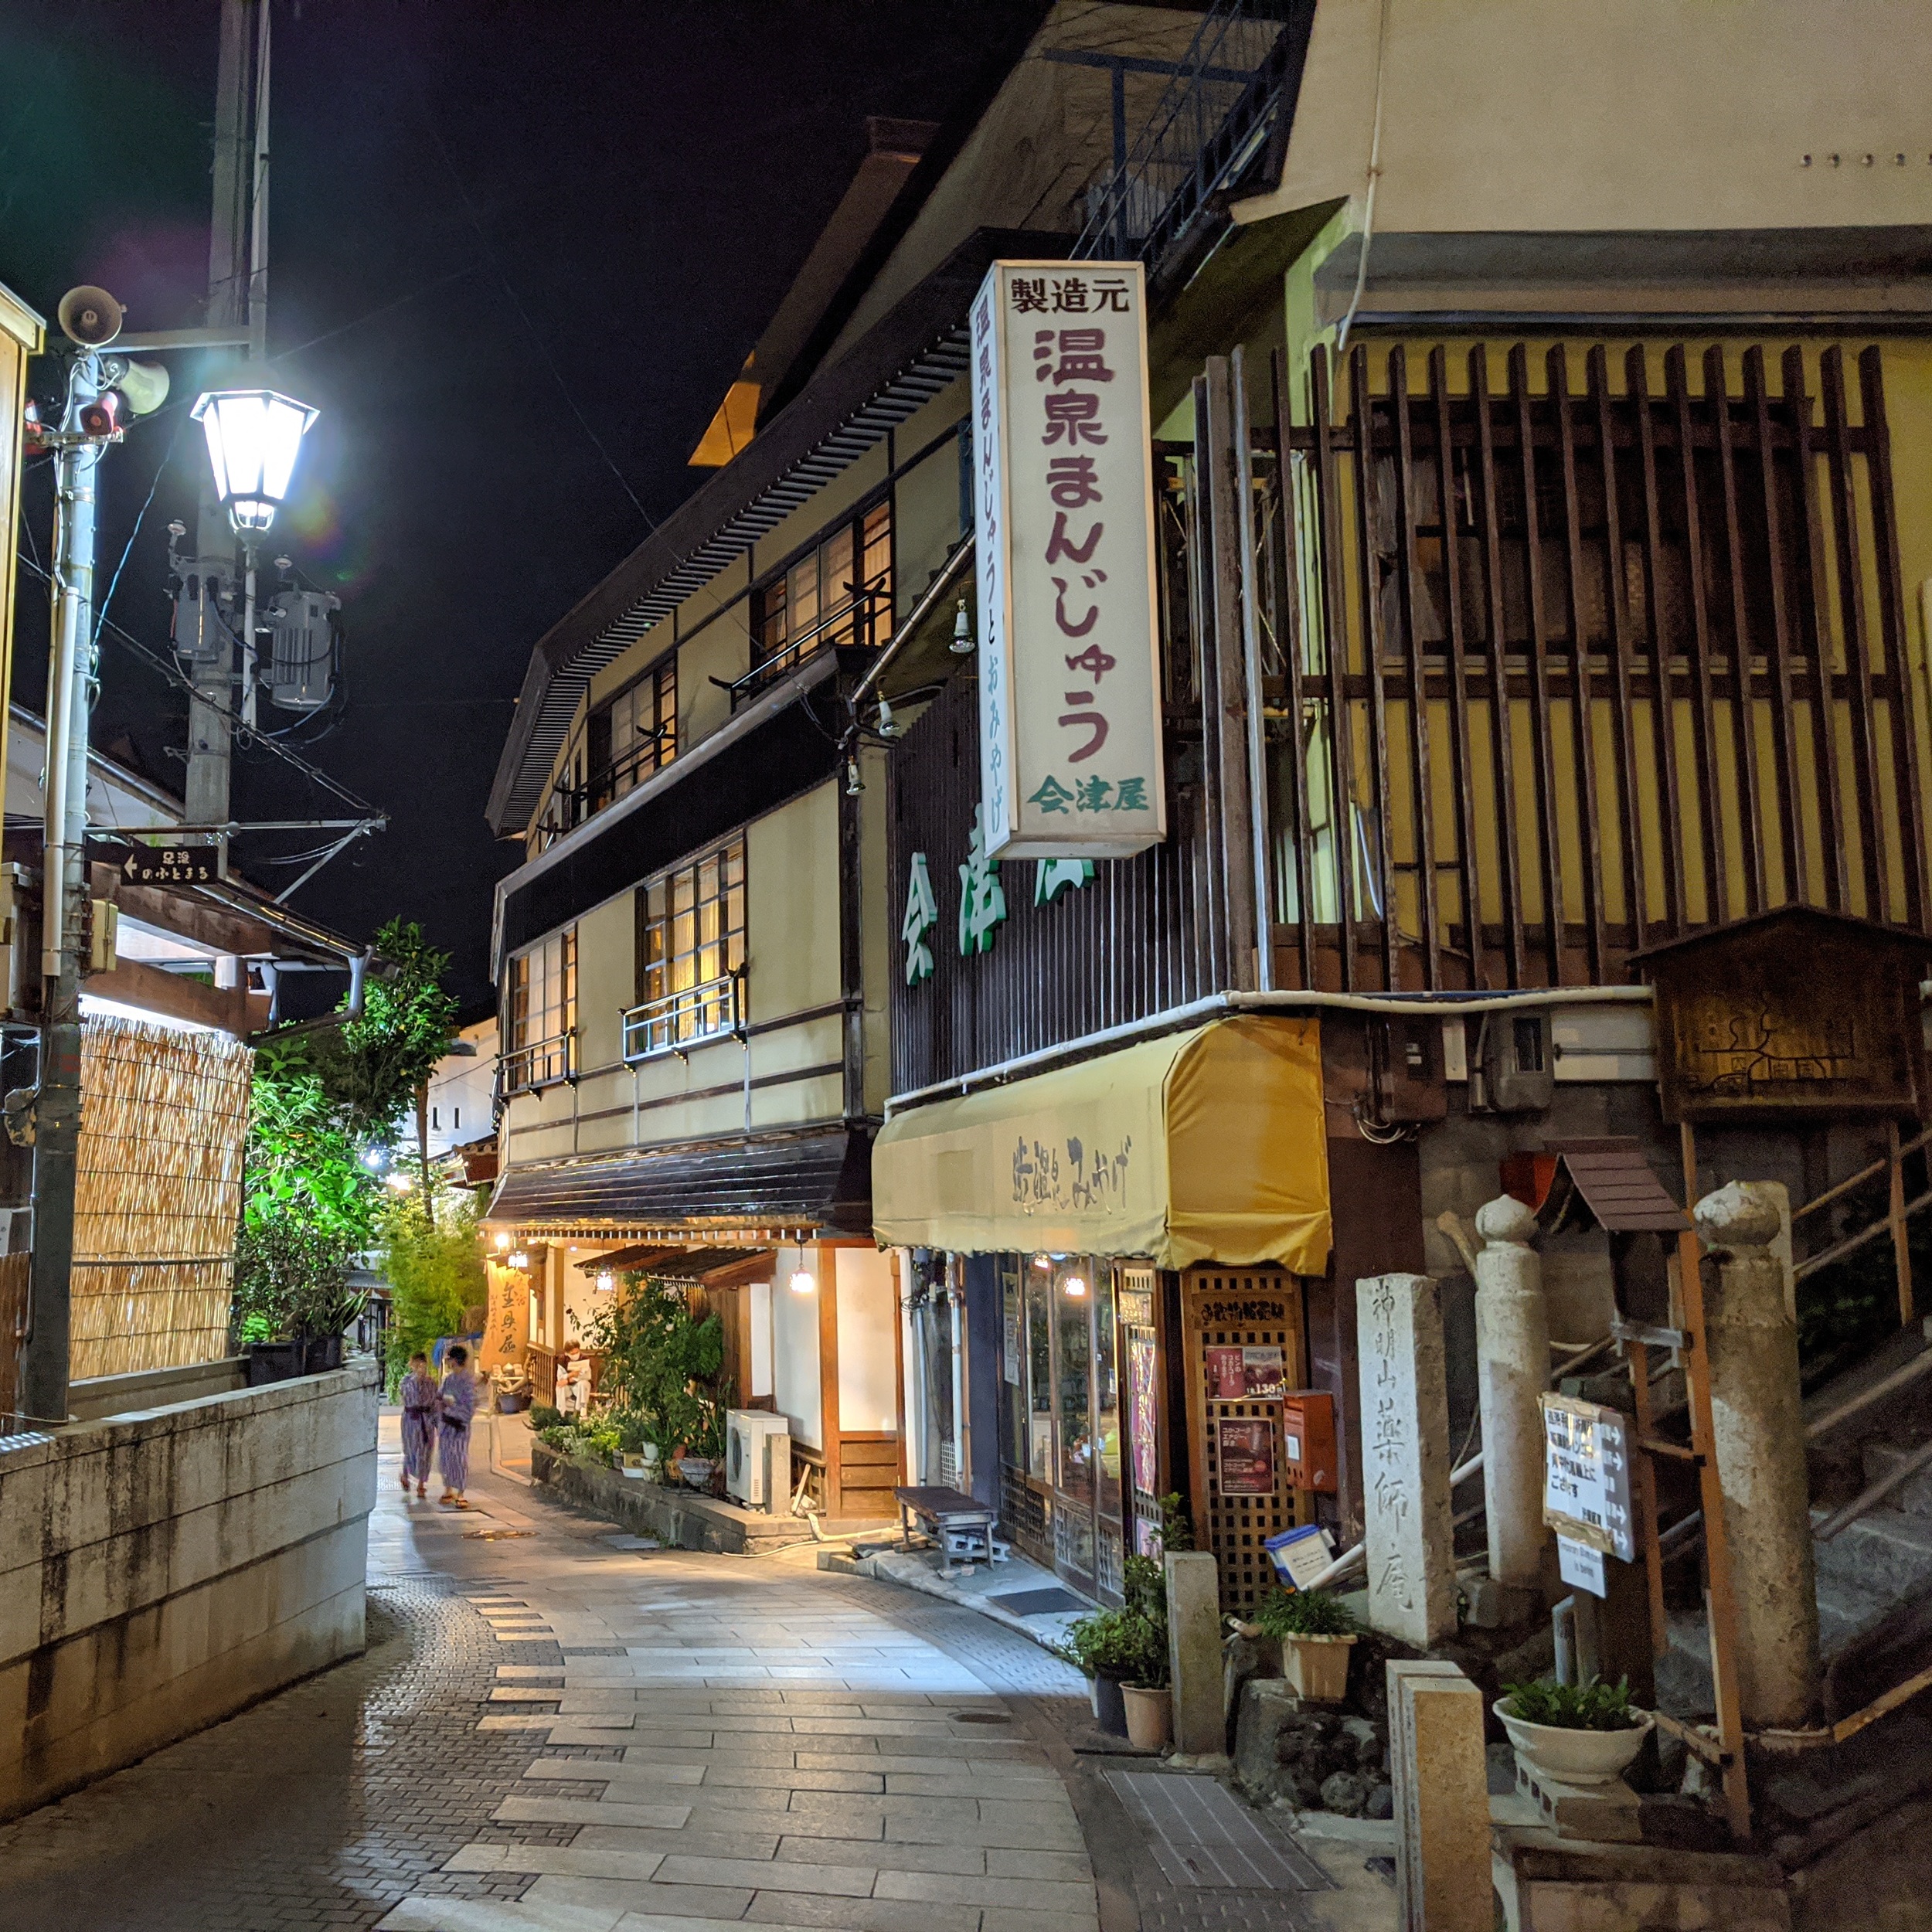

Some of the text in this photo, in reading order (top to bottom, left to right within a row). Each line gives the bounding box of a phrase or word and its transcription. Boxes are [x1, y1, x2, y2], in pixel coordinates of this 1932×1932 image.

[1011, 277, 1130, 313] 製造元
[1032, 328, 1117, 764] 温泉まんじゅう
[1026, 774, 1149, 815] 会津屋
[498, 1281, 519, 1354] 金具屋
